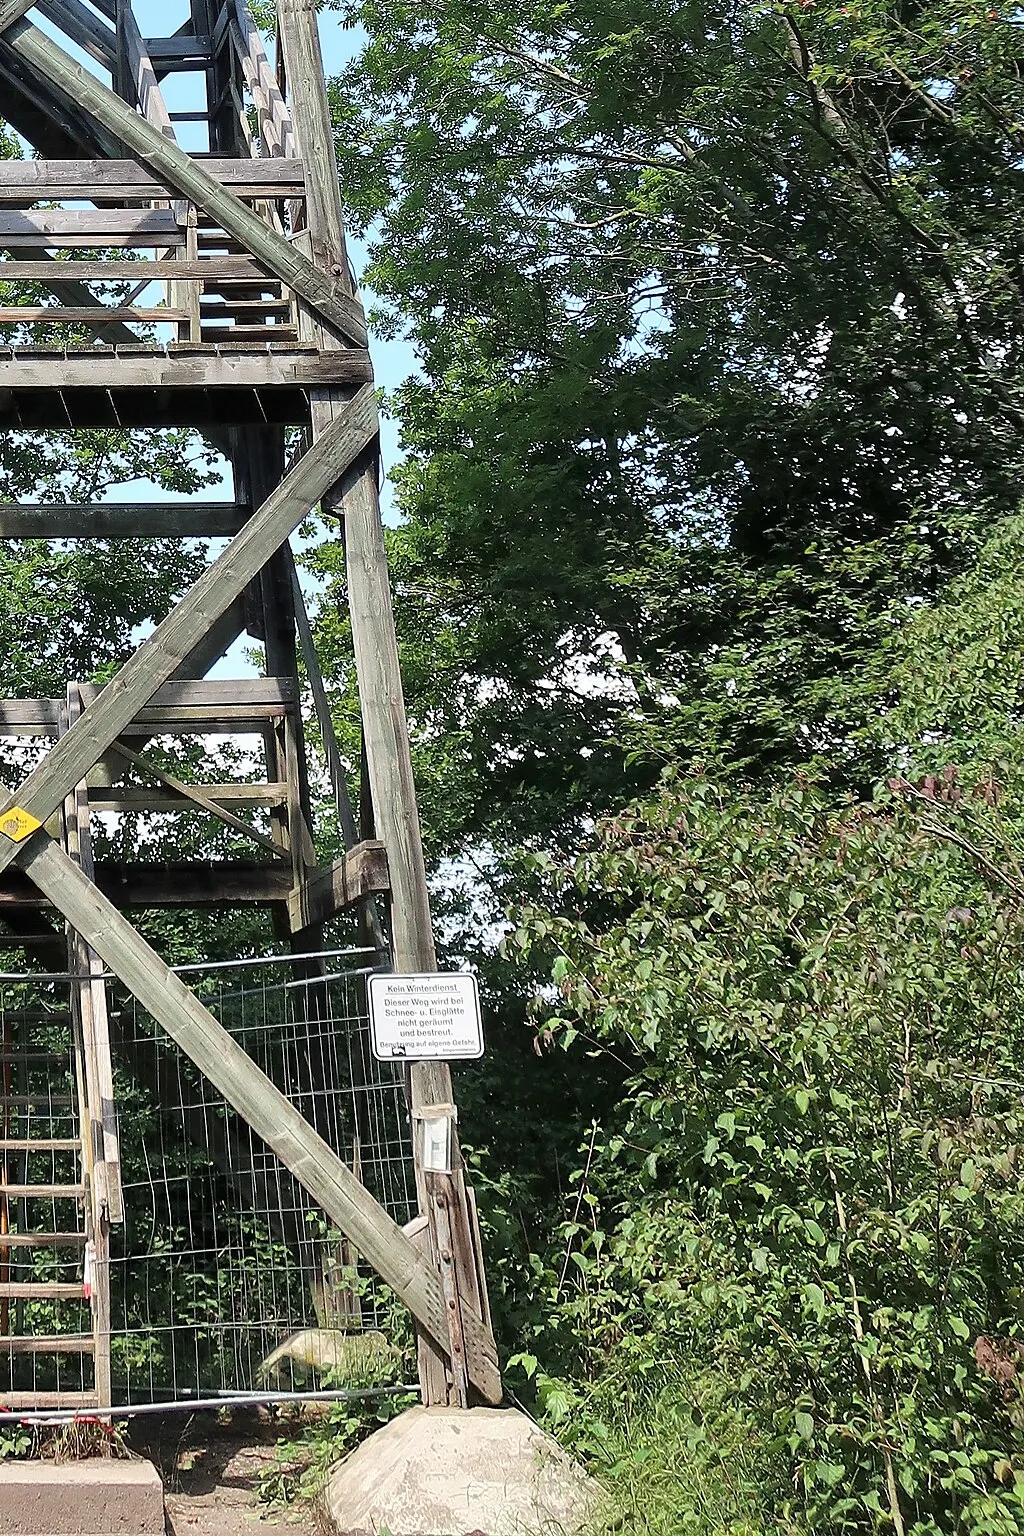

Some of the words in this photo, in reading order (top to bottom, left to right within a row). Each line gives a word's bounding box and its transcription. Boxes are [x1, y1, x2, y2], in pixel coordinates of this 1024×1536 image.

[387, 985, 405, 993] Kein
[406, 984, 457, 992] Winterdienst
[411, 998, 429, 1007] Weg
[430, 1008, 464, 1017] Eisglätte
[419, 1018, 453, 1027] geräumt
